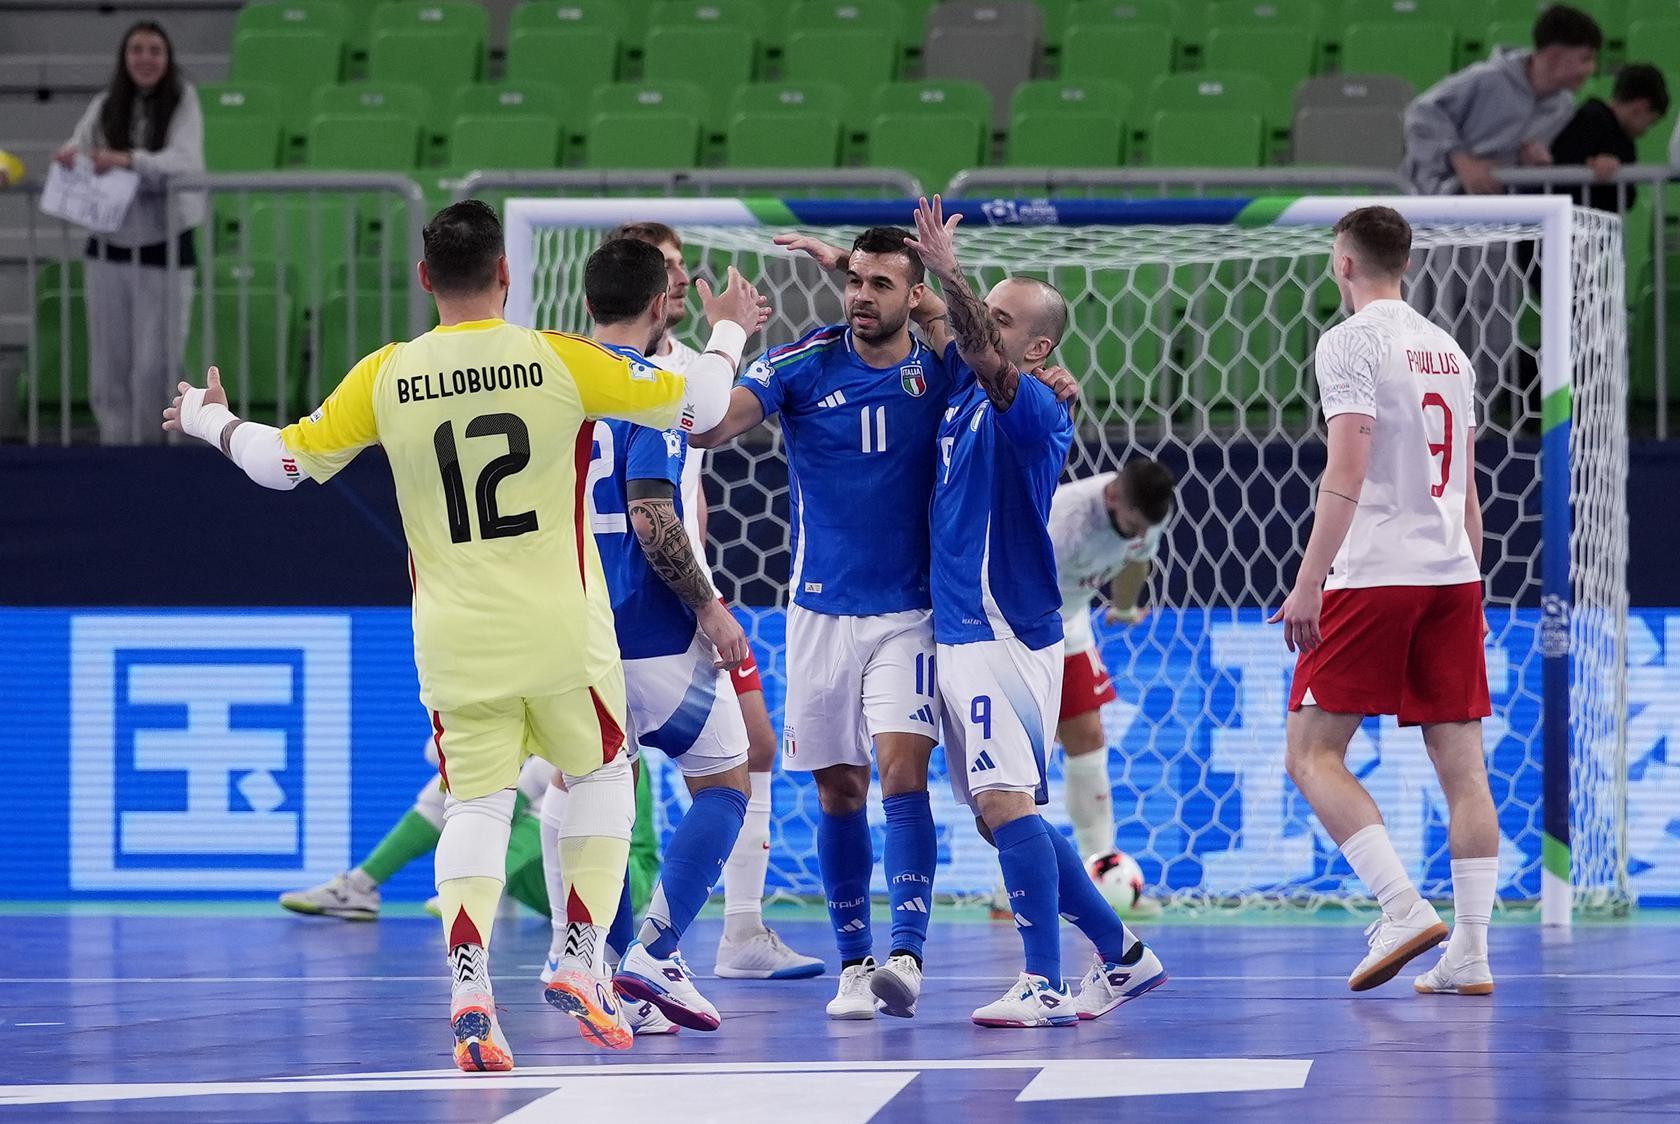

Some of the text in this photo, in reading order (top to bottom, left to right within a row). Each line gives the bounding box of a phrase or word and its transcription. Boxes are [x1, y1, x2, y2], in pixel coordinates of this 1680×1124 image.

[397, 362, 544, 404] BELLOBUONO
[903, 368, 921, 376] ITALIA
[1407, 350, 1460, 374] PAWLUS
[861, 406, 886, 453] 11
[1422, 393, 1453, 498] 9
[434, 412, 539, 544] 12
[586, 420, 628, 534] 2
[916, 652, 935, 698] 11
[971, 695, 991, 740] 9
[70, 615, 351, 891] 国
[893, 873, 930, 885] ITALIA
[829, 896, 865, 910] ITALIA
